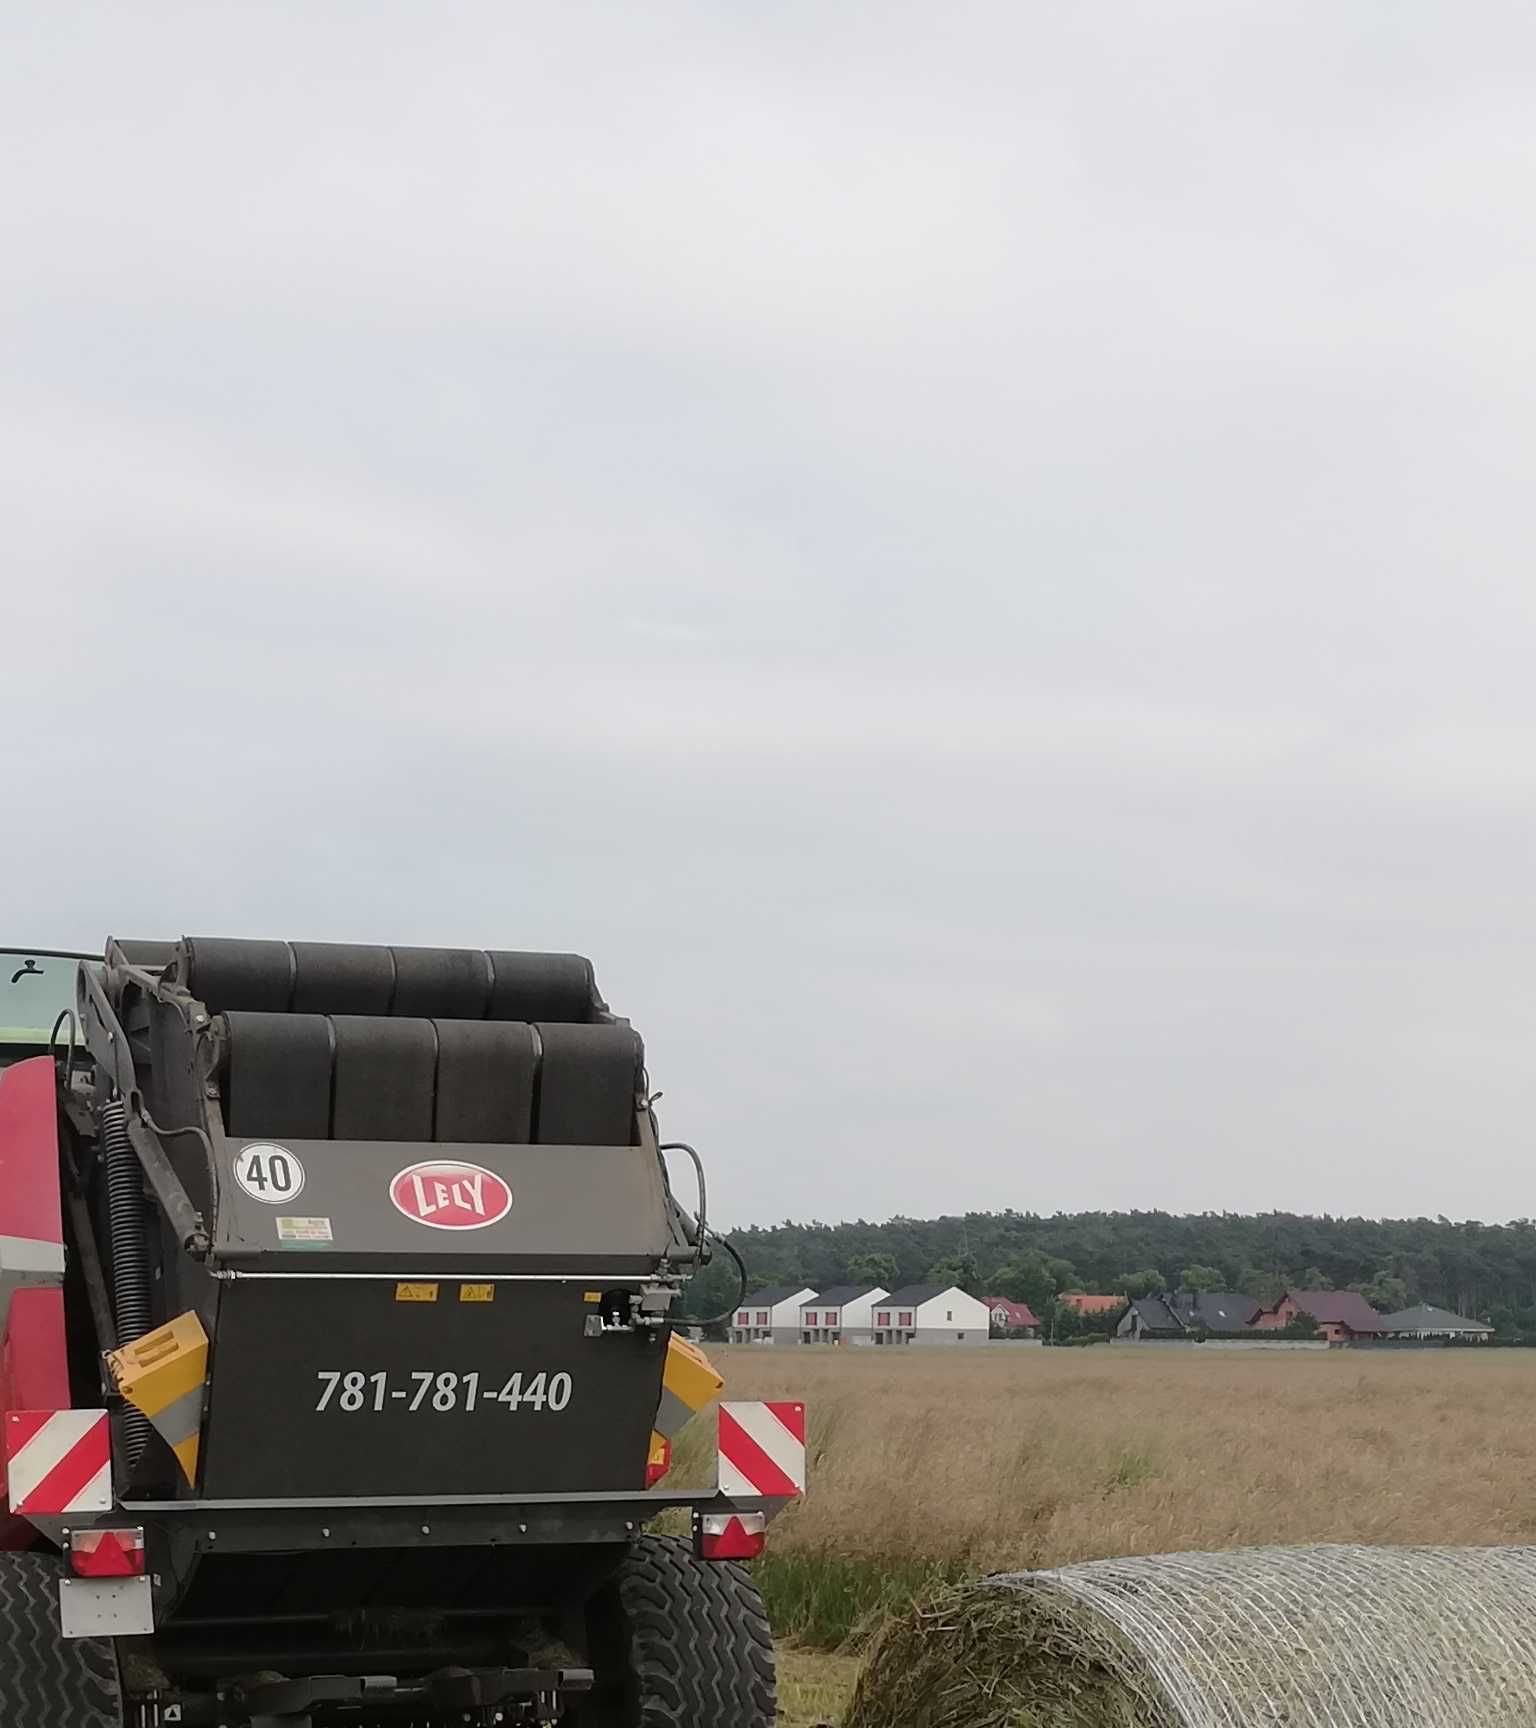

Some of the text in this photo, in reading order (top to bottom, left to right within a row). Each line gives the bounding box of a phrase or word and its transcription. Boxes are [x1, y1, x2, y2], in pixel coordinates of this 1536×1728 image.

[246, 1154, 292, 1192] 40
[412, 1173, 486, 1217] LELY
[315, 1371, 572, 1412] 781-781-440
